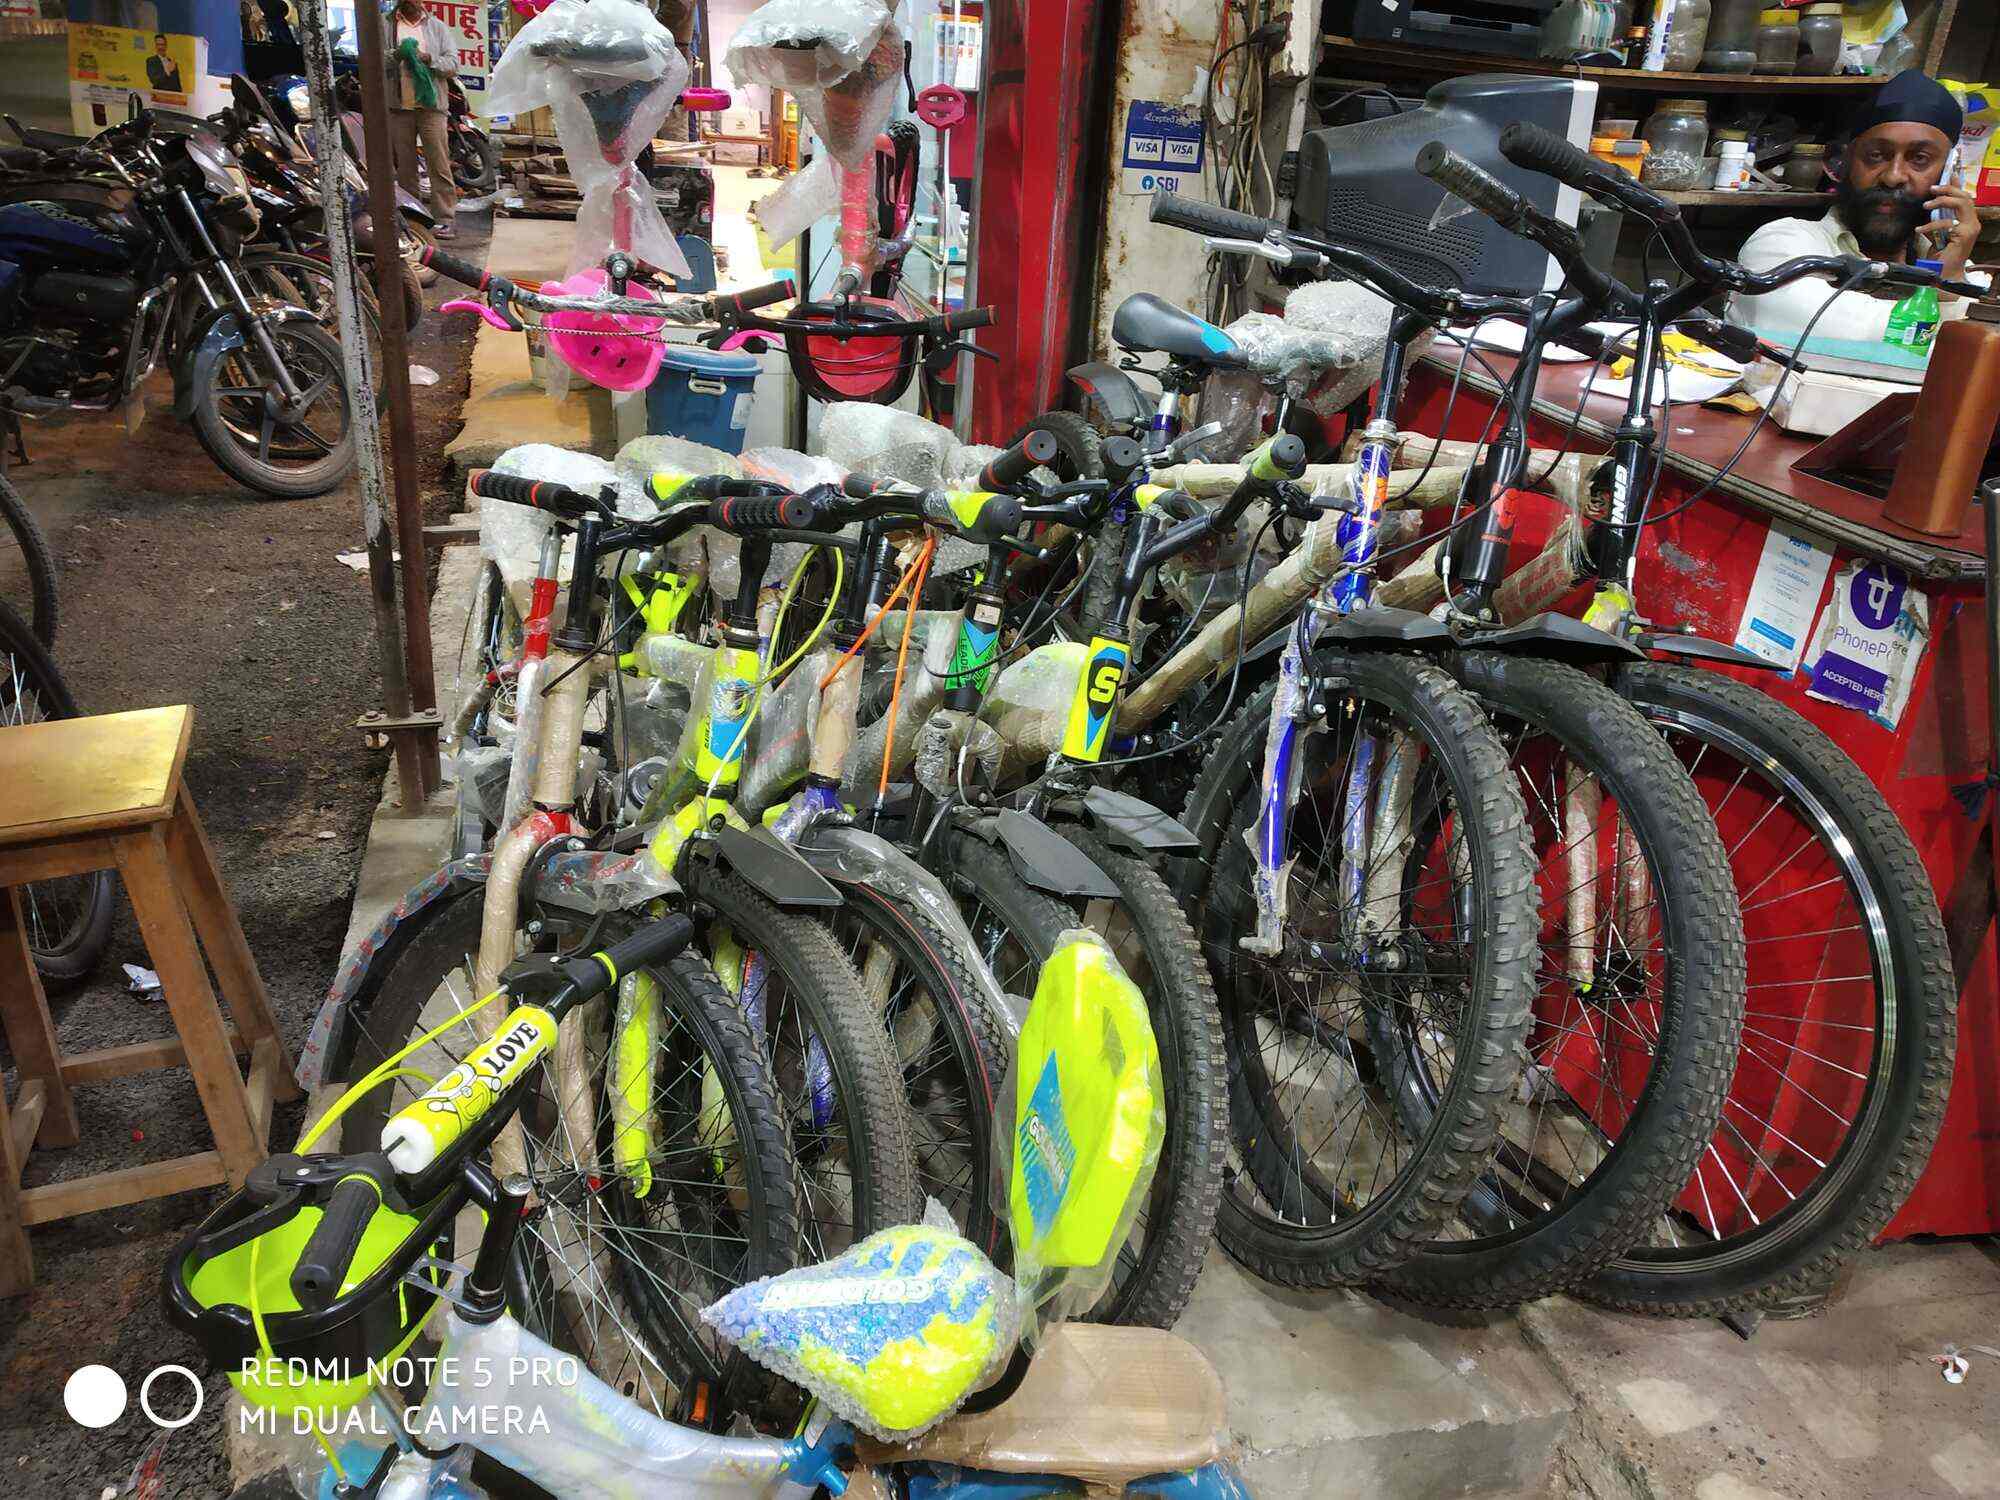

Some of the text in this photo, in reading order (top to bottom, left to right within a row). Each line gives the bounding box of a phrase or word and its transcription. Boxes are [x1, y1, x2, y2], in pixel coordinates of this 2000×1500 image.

[1134, 141, 1158, 153] VISA
[1171, 143, 1193, 155] VISA
[1156, 176, 1179, 192] SBI
[1834, 626, 1889, 659] PhoneP
[1822, 668, 1863, 694] ACCEPTED
[482, 1021, 539, 1075] LOVE
